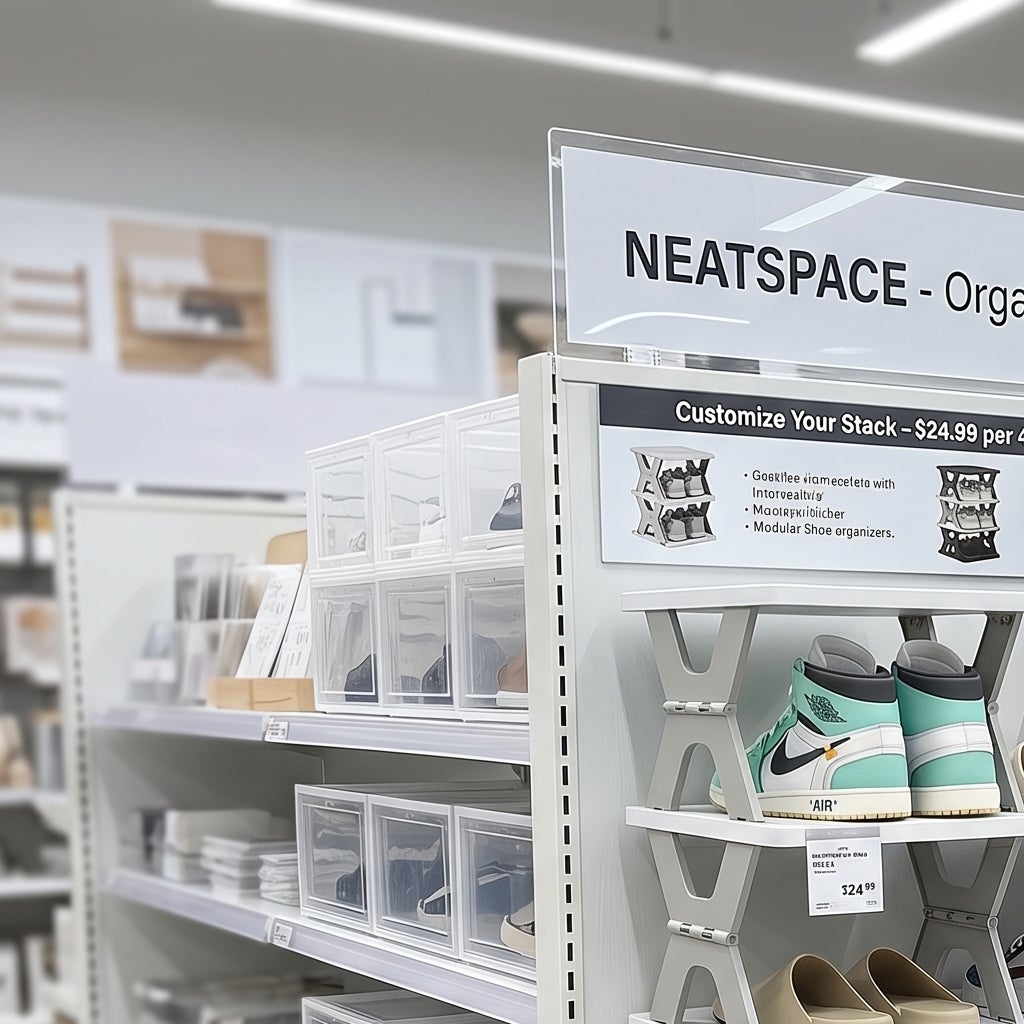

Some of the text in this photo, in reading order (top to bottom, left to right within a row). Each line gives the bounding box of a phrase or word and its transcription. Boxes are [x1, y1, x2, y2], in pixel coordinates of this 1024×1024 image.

[625, 230, 907, 307] NEATSPACE
[675, 400, 786, 429] Customize
[790, 409, 837, 433] Your
[841, 413, 898, 437] Stack
[915, 418, 978, 443] $24.99
[983, 428, 1014, 449] per
[872, 477, 896, 490] with
[753, 520, 895, 540] Modular Shoe organizers.
